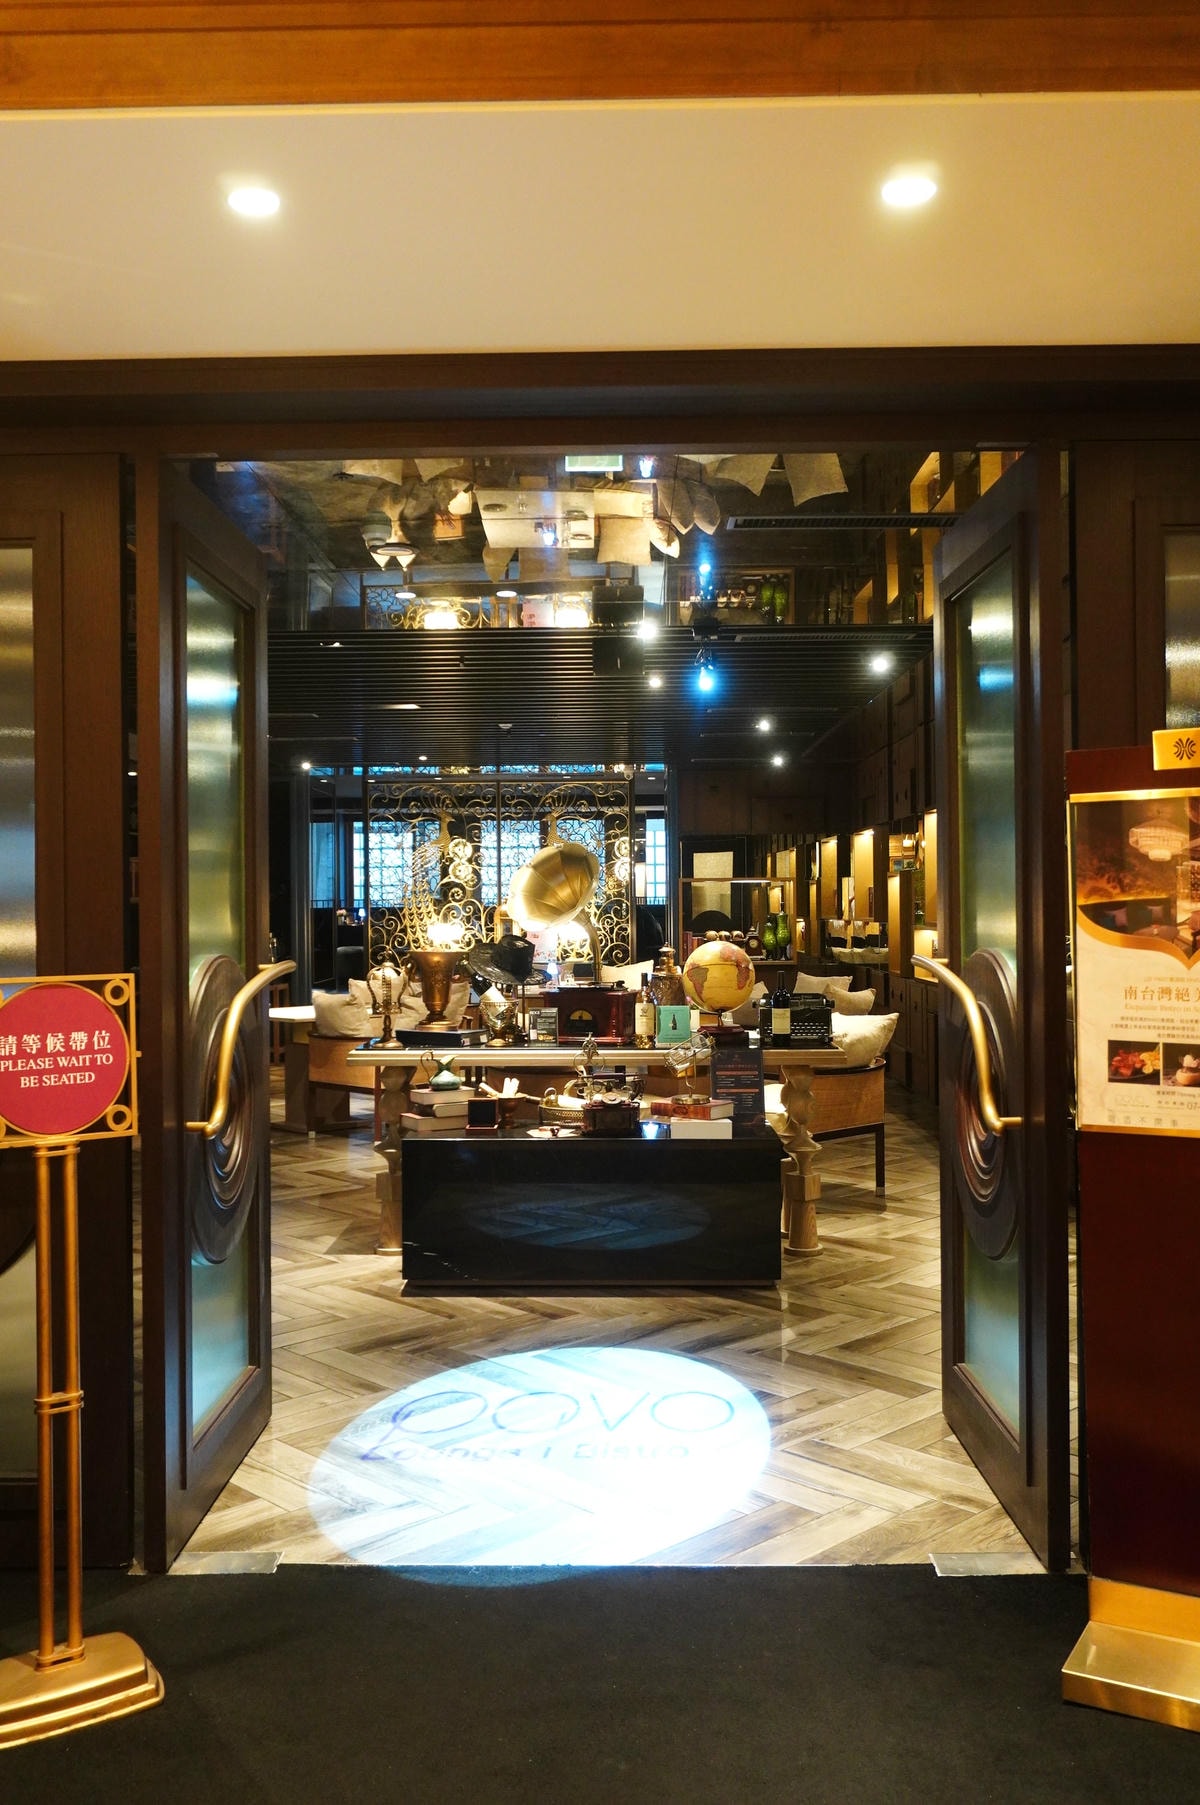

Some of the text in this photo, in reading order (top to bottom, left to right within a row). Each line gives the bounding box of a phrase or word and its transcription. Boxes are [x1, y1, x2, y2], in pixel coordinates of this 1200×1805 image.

[0, 1030, 111, 1056] 請等候帶位
[0, 1053, 114, 1072] PLEASE WAIT TO
[20, 1071, 95, 1088] BE SEATED
